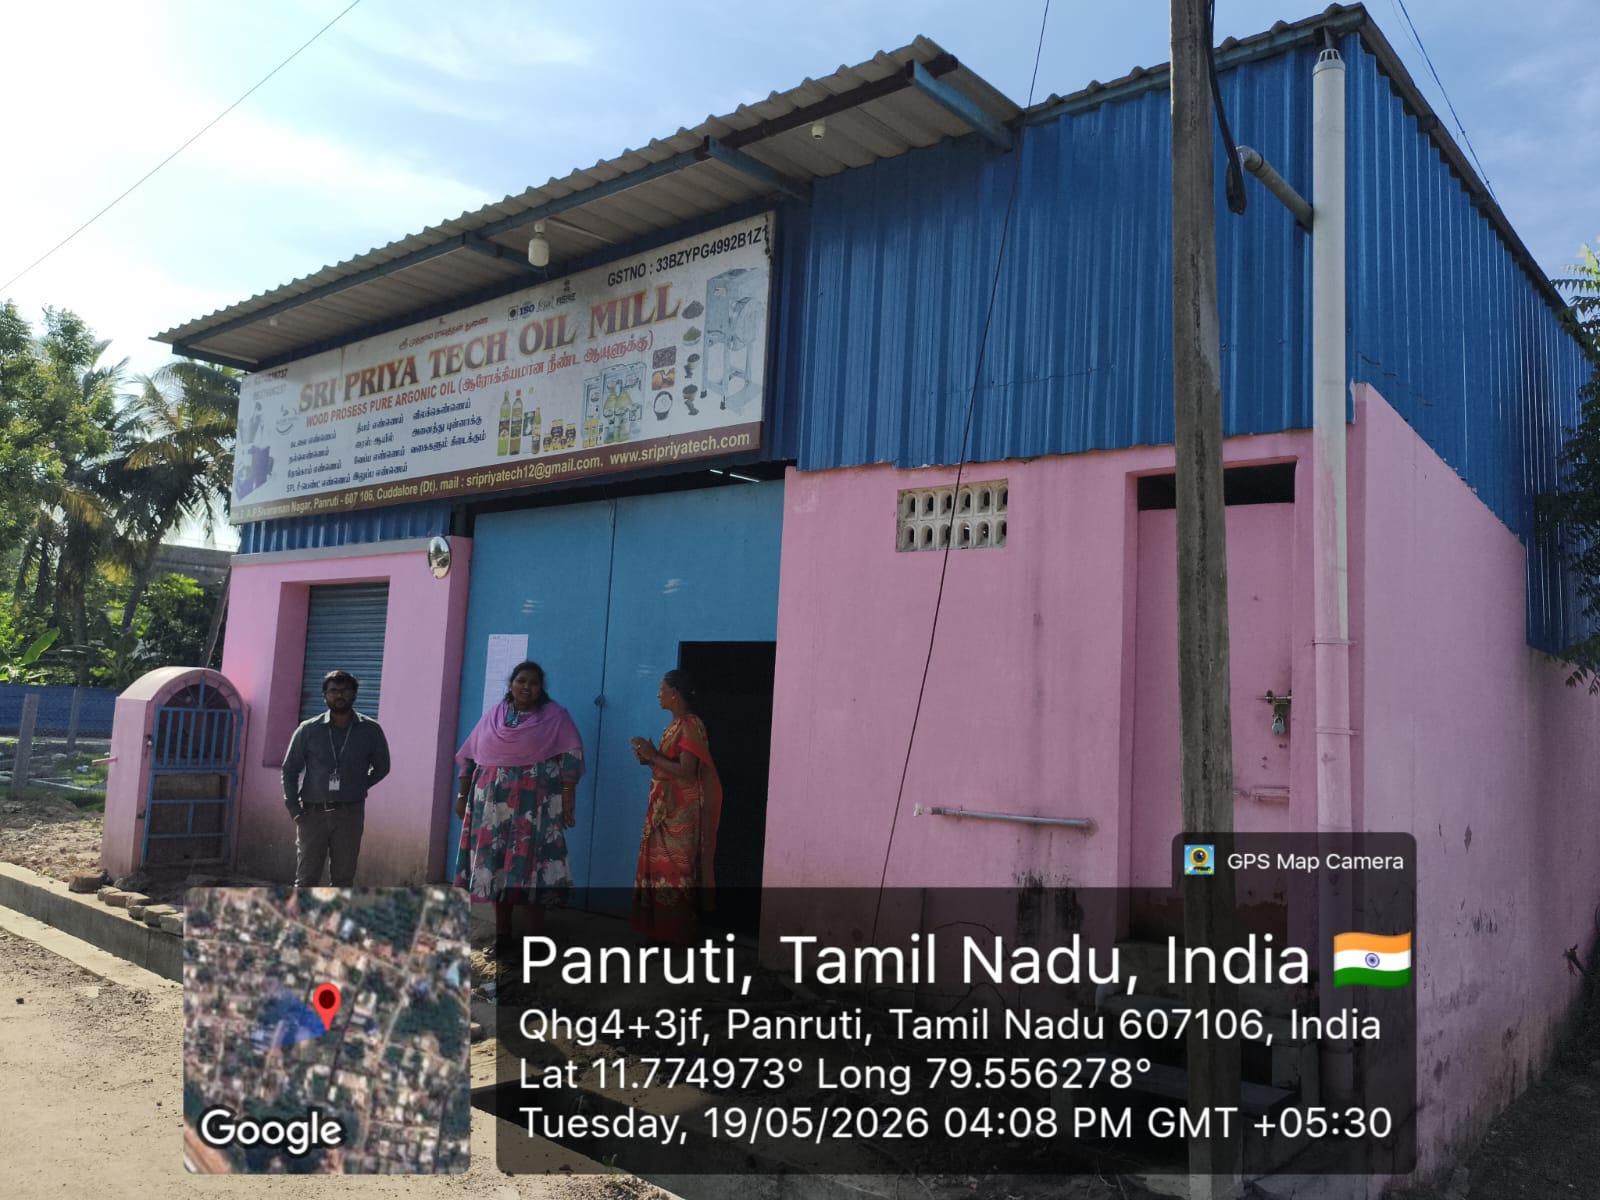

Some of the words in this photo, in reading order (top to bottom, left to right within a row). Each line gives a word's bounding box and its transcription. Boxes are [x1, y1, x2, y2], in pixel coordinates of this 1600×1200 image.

[520, 304, 535, 315] ISO
[608, 262, 647, 287] GSTNO
[300, 378, 337, 412] SRI
[343, 354, 420, 402] PRIYA
[428, 329, 508, 380] TECH
[519, 314, 576, 355] OIL
[588, 281, 683, 339] MILL
[306, 412, 329, 427] WOOD
[330, 402, 368, 420] PROSESS
[369, 395, 394, 412] PURE
[395, 386, 437, 406] ARGONIC
[439, 380, 456, 395] OIL
[547, 352, 580, 374] நீண்ட
[313, 495, 339, 509] Panruti
[344, 492, 357, 504] 607
[359, 488, 375, 502] 106,
[376, 483, 417, 500] Cuddalore
[440, 476, 459, 491] mail
[610, 431, 750, 464] www.sripriyatech.com
